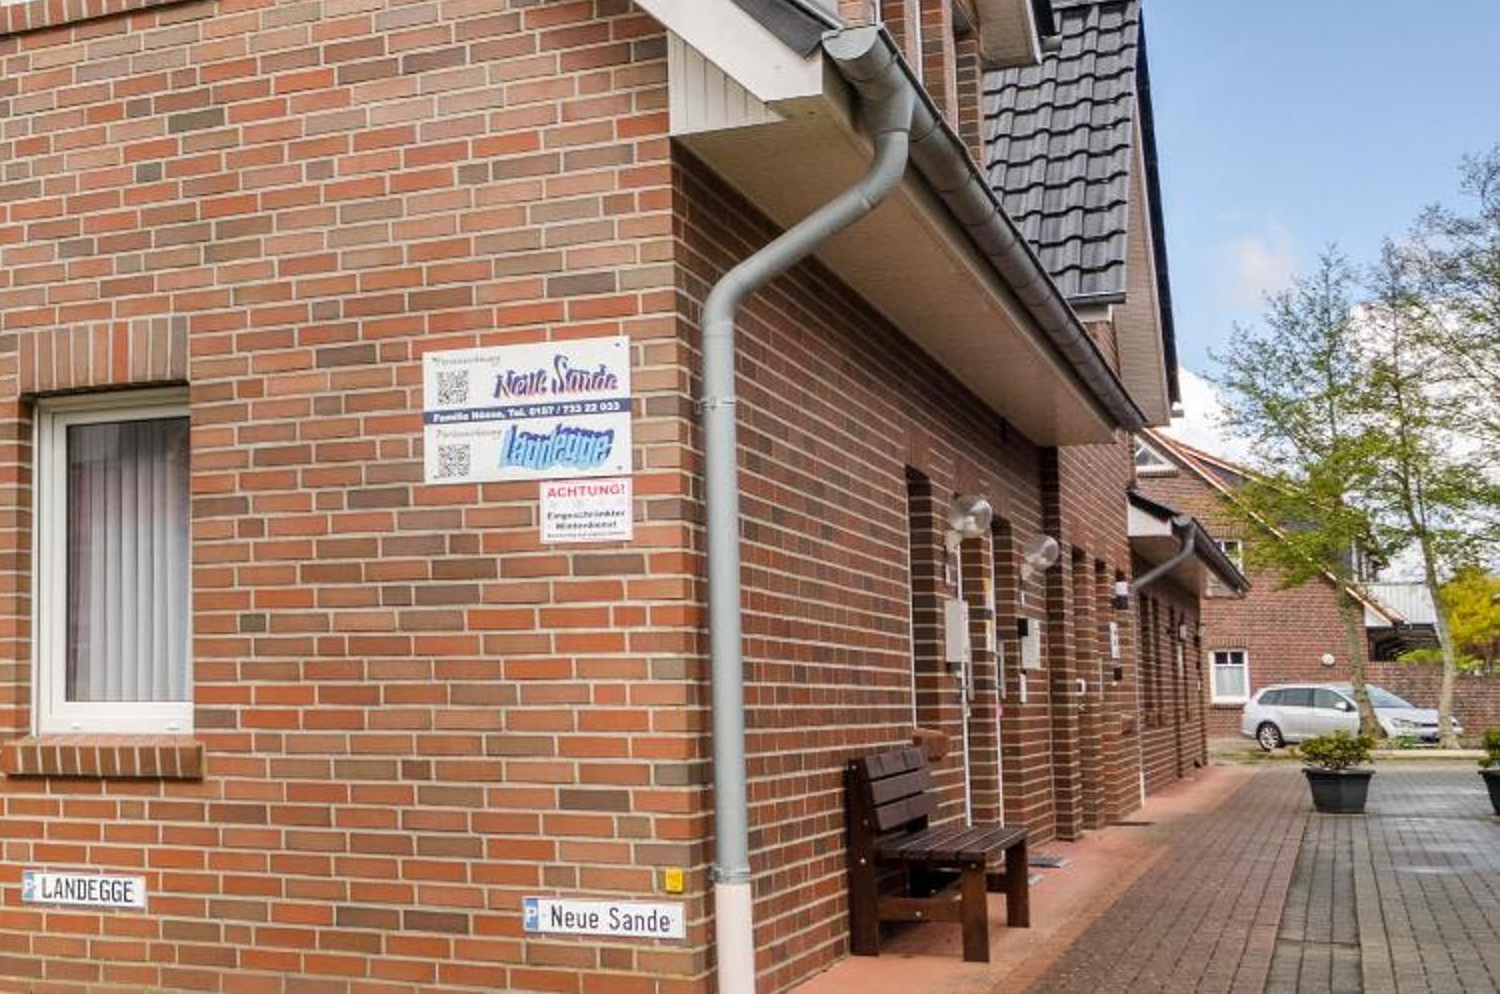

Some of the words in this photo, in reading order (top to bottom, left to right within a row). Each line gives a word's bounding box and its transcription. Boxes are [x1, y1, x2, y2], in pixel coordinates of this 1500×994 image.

[547, 483, 626, 498] ACHTUNG!
[41, 877, 133, 903] LANDEGGE
[551, 905, 599, 929] Neue
[609, 907, 670, 932] Sande
